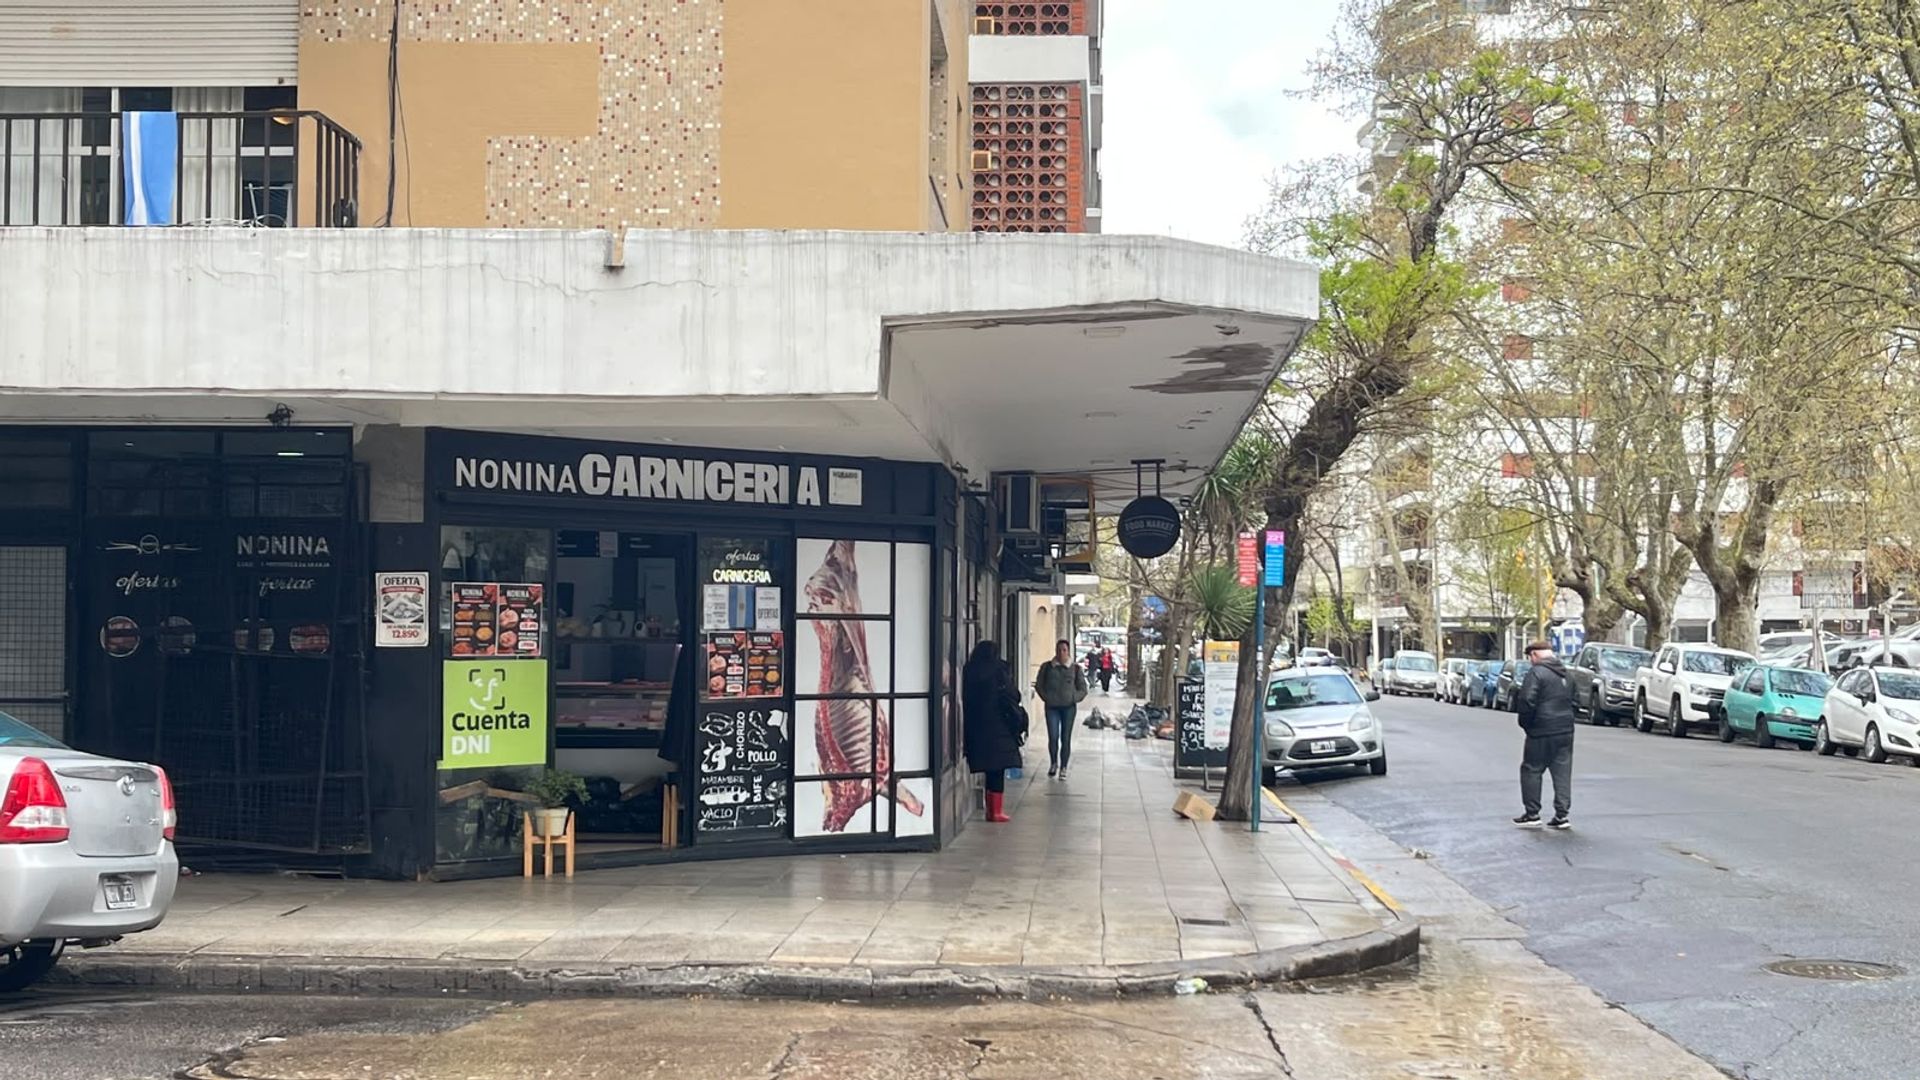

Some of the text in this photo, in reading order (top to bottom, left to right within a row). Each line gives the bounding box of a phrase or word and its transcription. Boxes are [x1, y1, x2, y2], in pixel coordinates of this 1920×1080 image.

[456, 457, 577, 493] NONINA
[237, 535, 330, 556] NONINA
[725, 549, 760, 565] ofertas
[383, 576, 421, 586] OFERTA
[712, 569, 772, 584] CARNICERIA
[451, 710, 531, 731] Cuenta
[451, 734, 491, 755] DNI
[736, 711, 745, 759] CHORIZO
[748, 750, 777, 762] POLLO
[753, 775, 763, 802] BIFE
